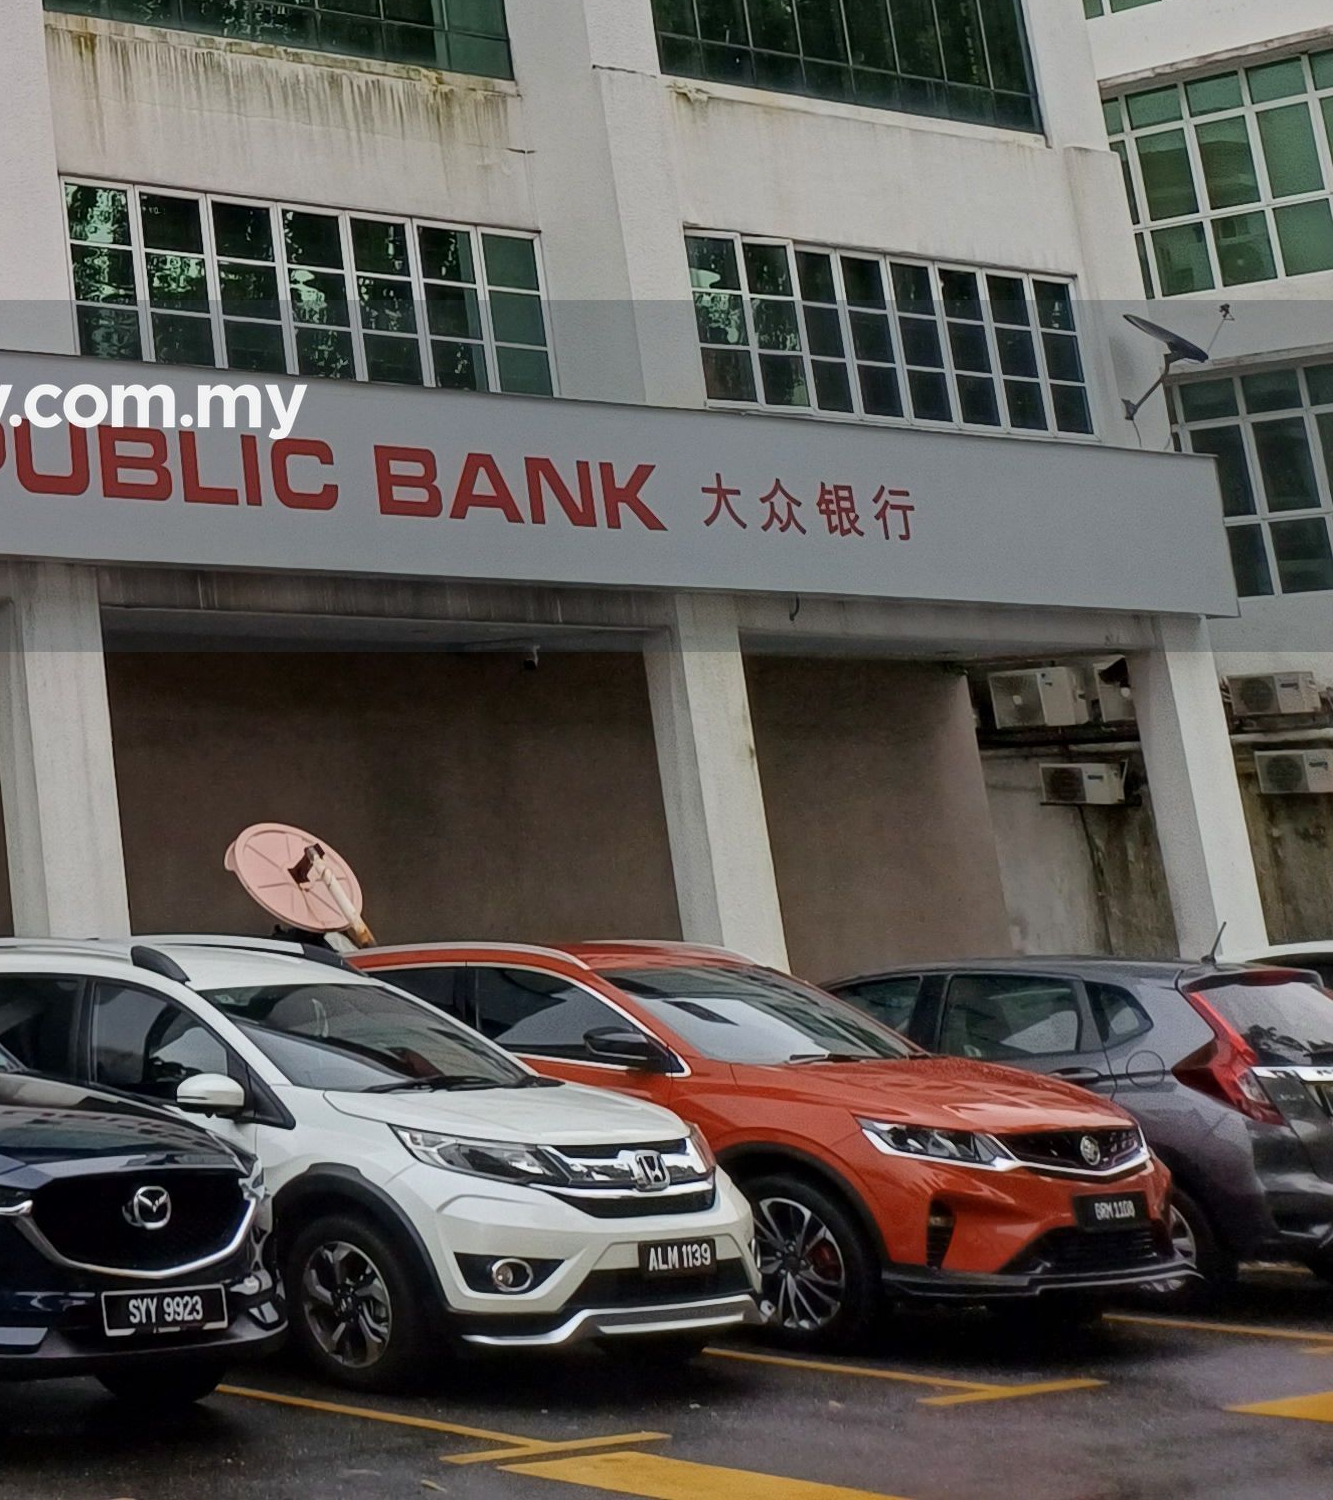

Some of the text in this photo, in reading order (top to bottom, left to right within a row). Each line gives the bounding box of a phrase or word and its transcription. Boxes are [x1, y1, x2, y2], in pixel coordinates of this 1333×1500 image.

[372, 443, 667, 531] BANK
[701, 472, 915, 541] 大众银行
[648, 1243, 711, 1271] ALM 1139
[128, 1295, 203, 1323] SYY 9923
